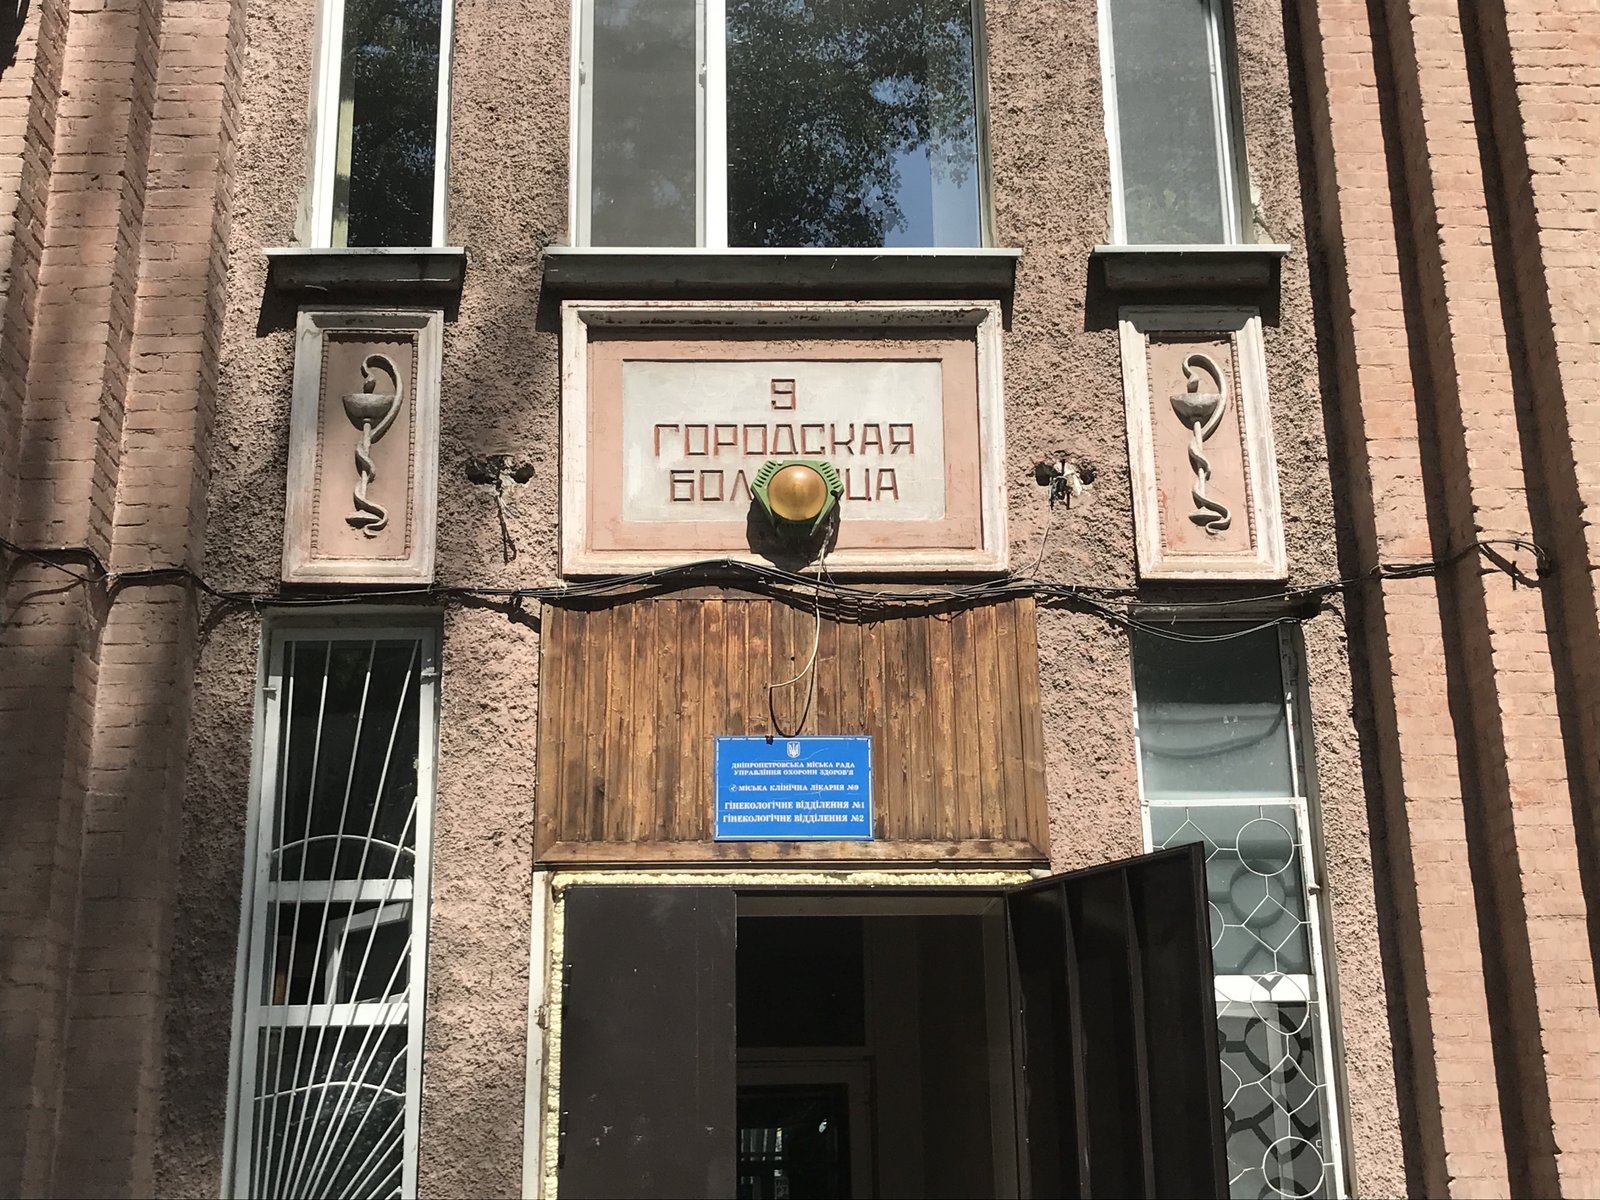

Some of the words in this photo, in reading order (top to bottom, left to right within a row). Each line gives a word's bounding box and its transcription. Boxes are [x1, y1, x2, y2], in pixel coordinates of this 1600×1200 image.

[653, 423, 915, 456] ГОРОДСКАЯ
[669, 468, 899, 502] БОЛЦА
[835, 761, 856, 769] РАДА
[738, 784, 768, 792] МІСЬКА
[769, 784, 808, 792] КЛІНІЧНА
[724, 800, 794, 810] ГІНЕКОЛОГІЧНЕ
[795, 800, 850, 810] ВІДДІЛЕННЯ
[851, 801, 865, 809] №1
[722, 813, 792, 823] ГІНЕКОЛОГІЧНЕ
[793, 813, 848, 823] ВІДДІЛЕННЯ
[850, 814, 865, 822] №2
